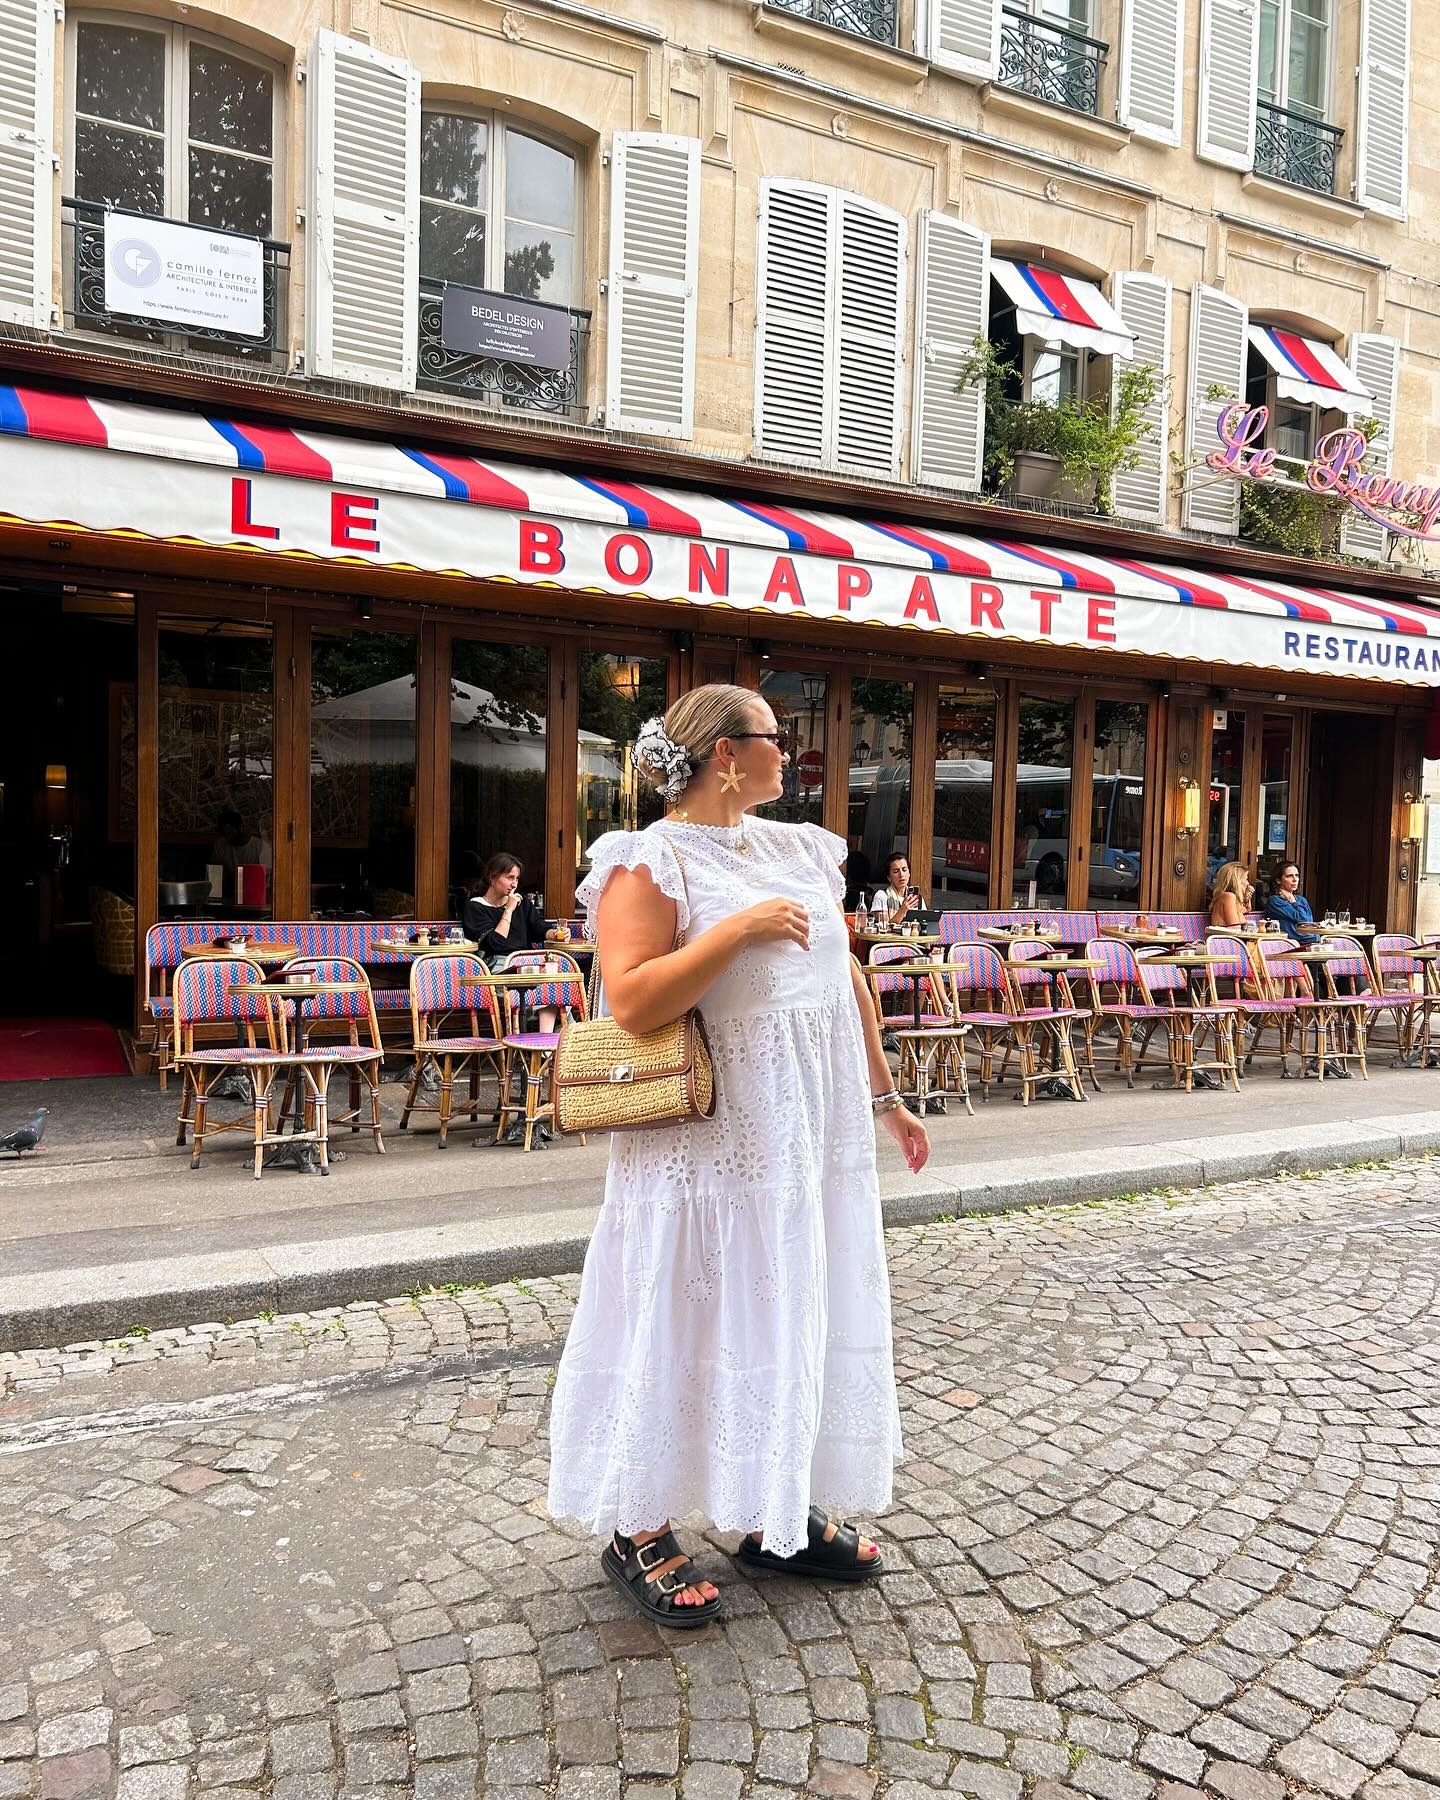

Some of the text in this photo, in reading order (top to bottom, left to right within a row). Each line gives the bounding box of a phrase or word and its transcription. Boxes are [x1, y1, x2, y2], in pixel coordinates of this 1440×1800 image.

[166, 273, 217, 288] ARCHITECTURE
[167, 262, 214, 276] camille
[472, 306, 544, 330] BEDEL DESIGN
[1206, 403, 1277, 478] Le
[231, 476, 1117, 643] LE BONAPARTE
